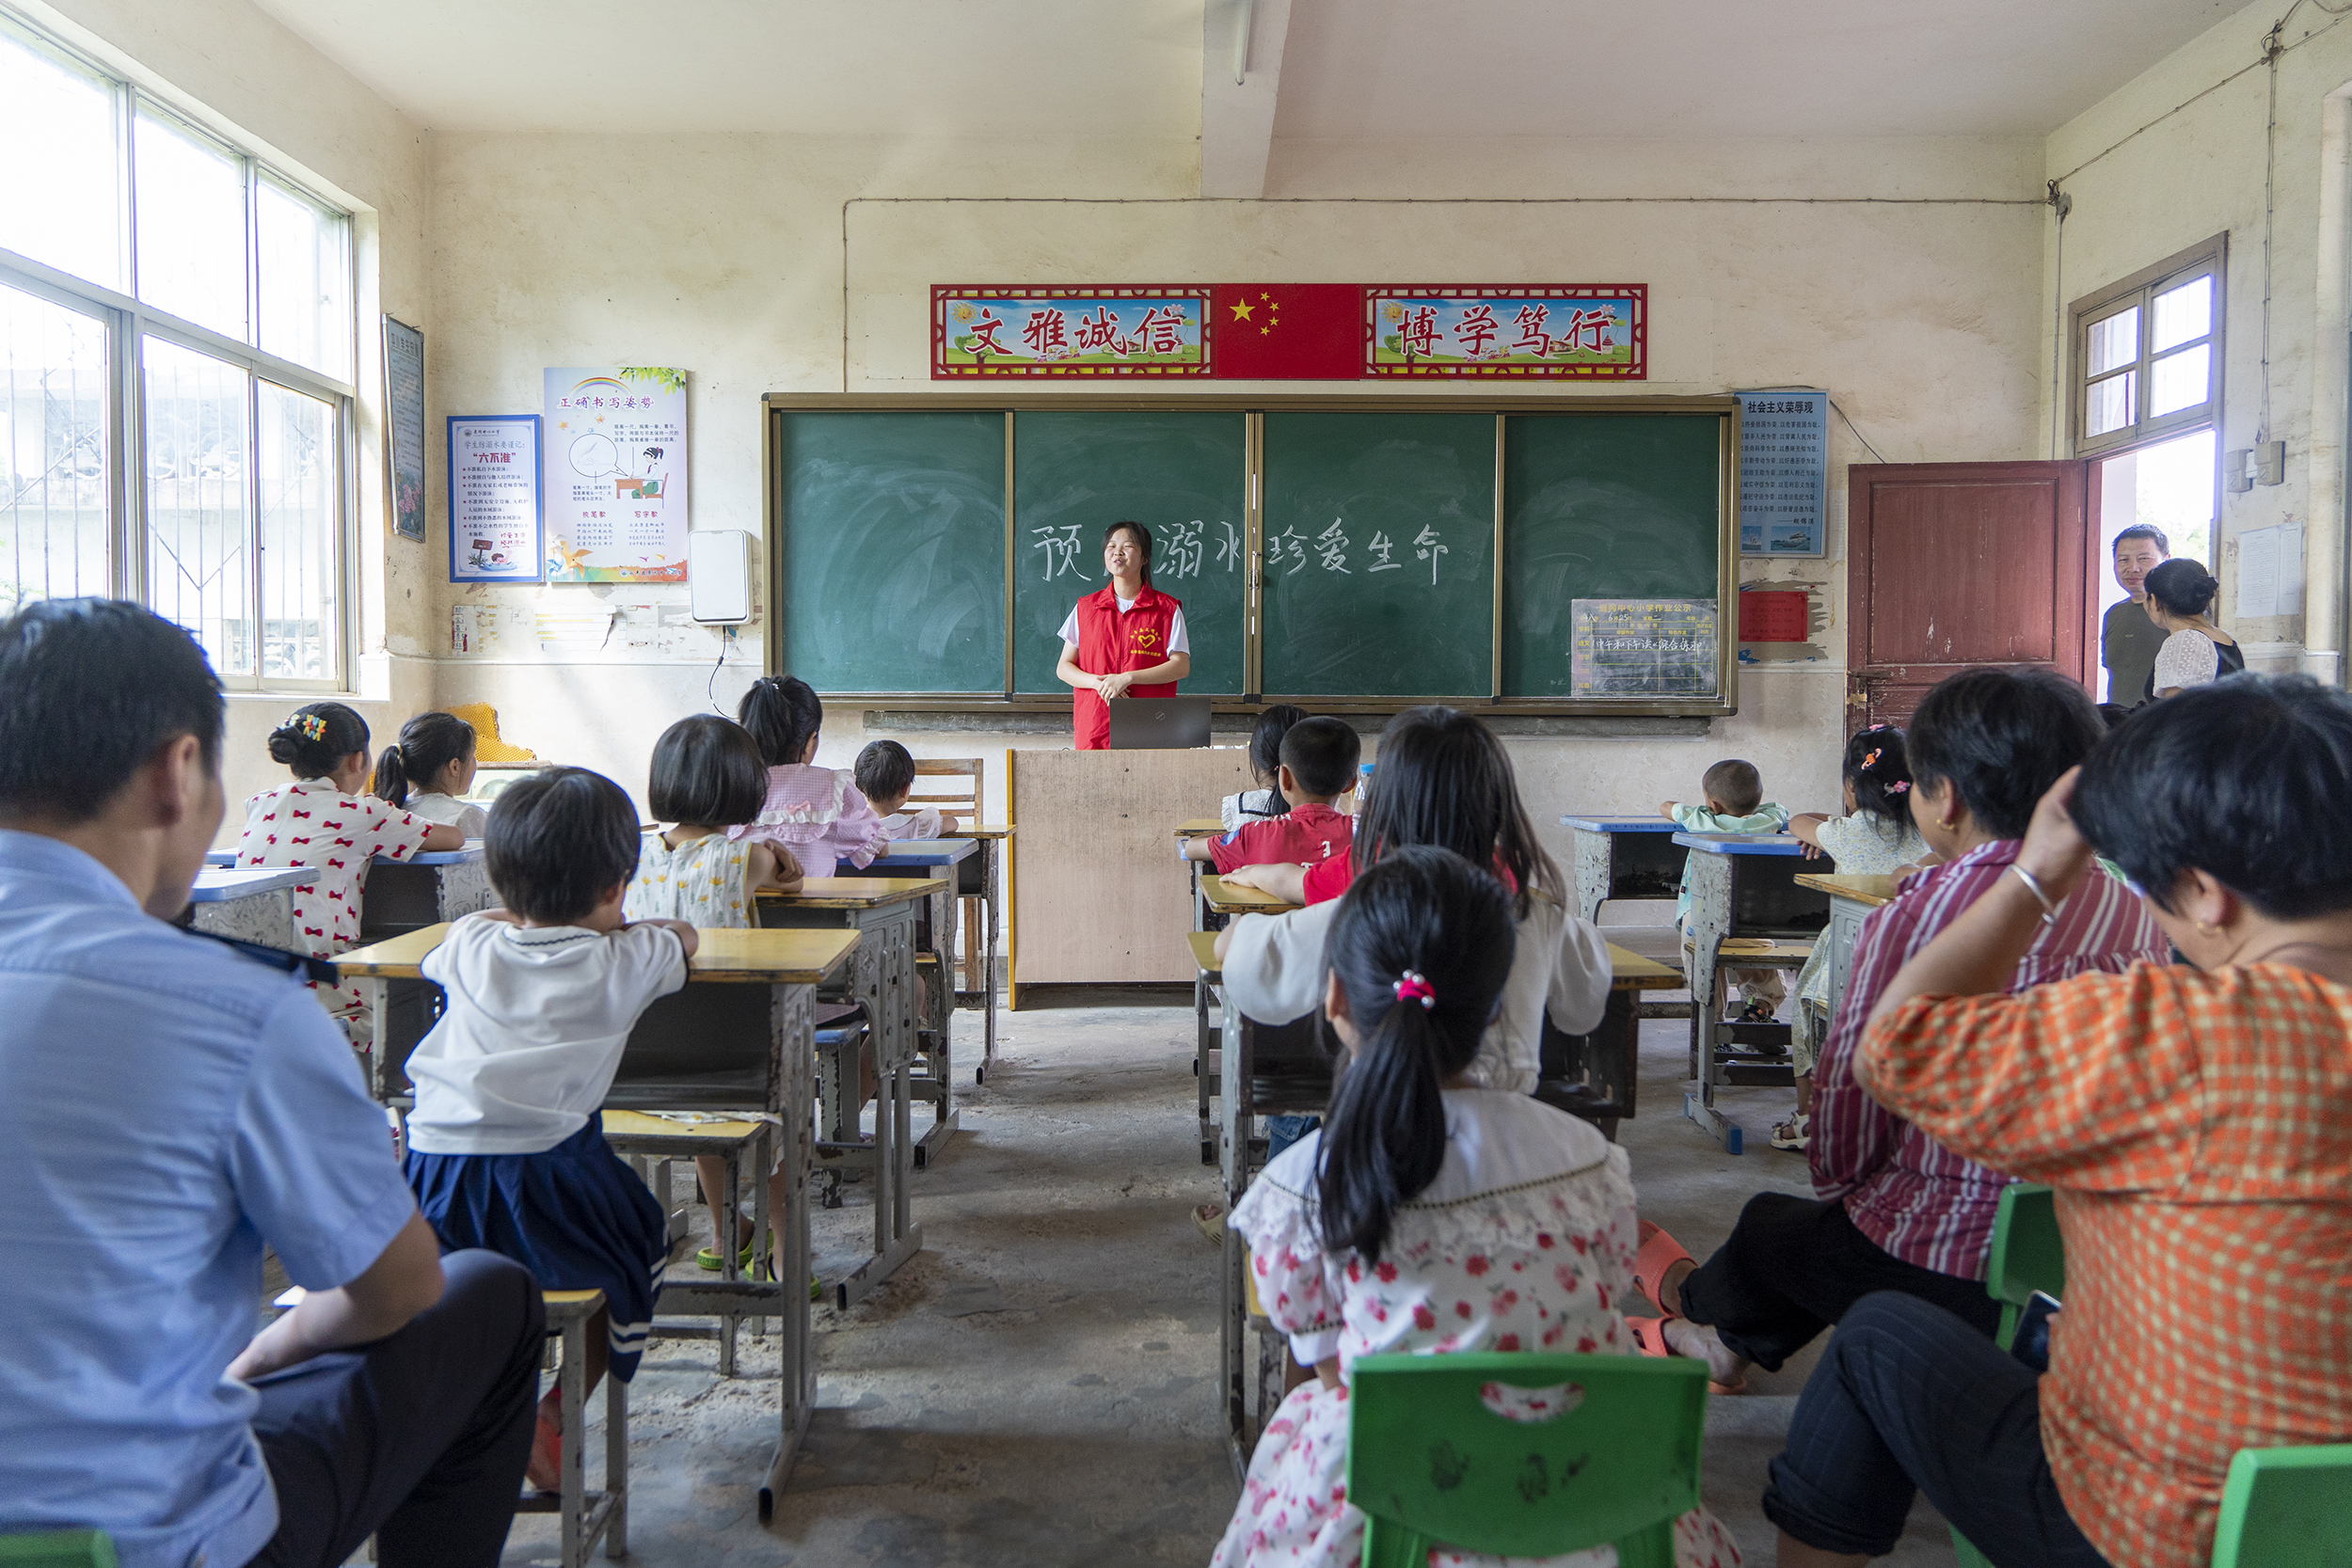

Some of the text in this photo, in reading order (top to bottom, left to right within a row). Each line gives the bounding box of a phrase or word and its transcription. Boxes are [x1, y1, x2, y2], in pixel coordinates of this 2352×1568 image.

[966, 305, 1183, 357] 文雅诚信
[1396, 305, 1614, 358] 博学笃行
[558, 396, 654, 409] 正确书写姿势
[1747, 401, 1814, 414] 社会主义荣辱观
[472, 452, 516, 464] “六不准”
[1268, 516, 1449, 586] 珍爱生命
